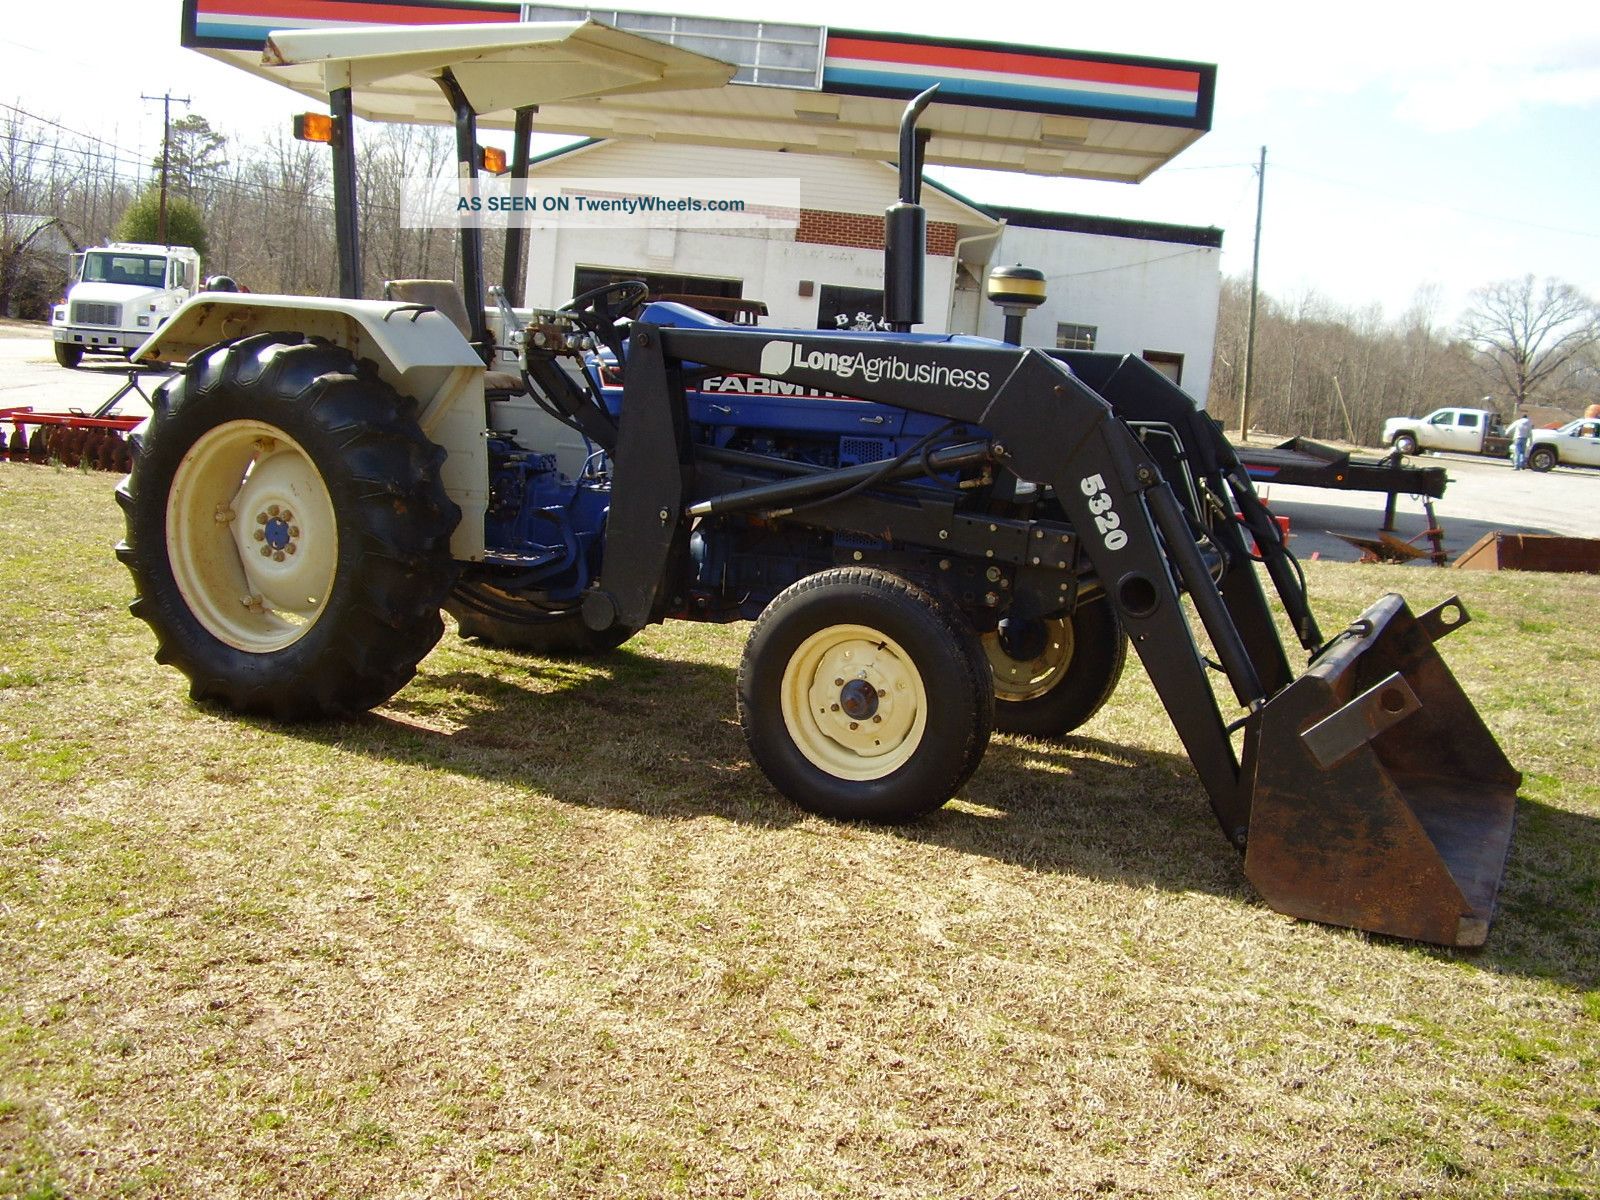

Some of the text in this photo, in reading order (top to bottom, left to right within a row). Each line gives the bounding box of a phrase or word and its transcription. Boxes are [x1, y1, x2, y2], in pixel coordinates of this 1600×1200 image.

[834, 313, 849, 326] B
[855, 311, 873, 322] &
[794, 343, 990, 391] LongAgribusiness
[1080, 473, 1128, 551] 5320
